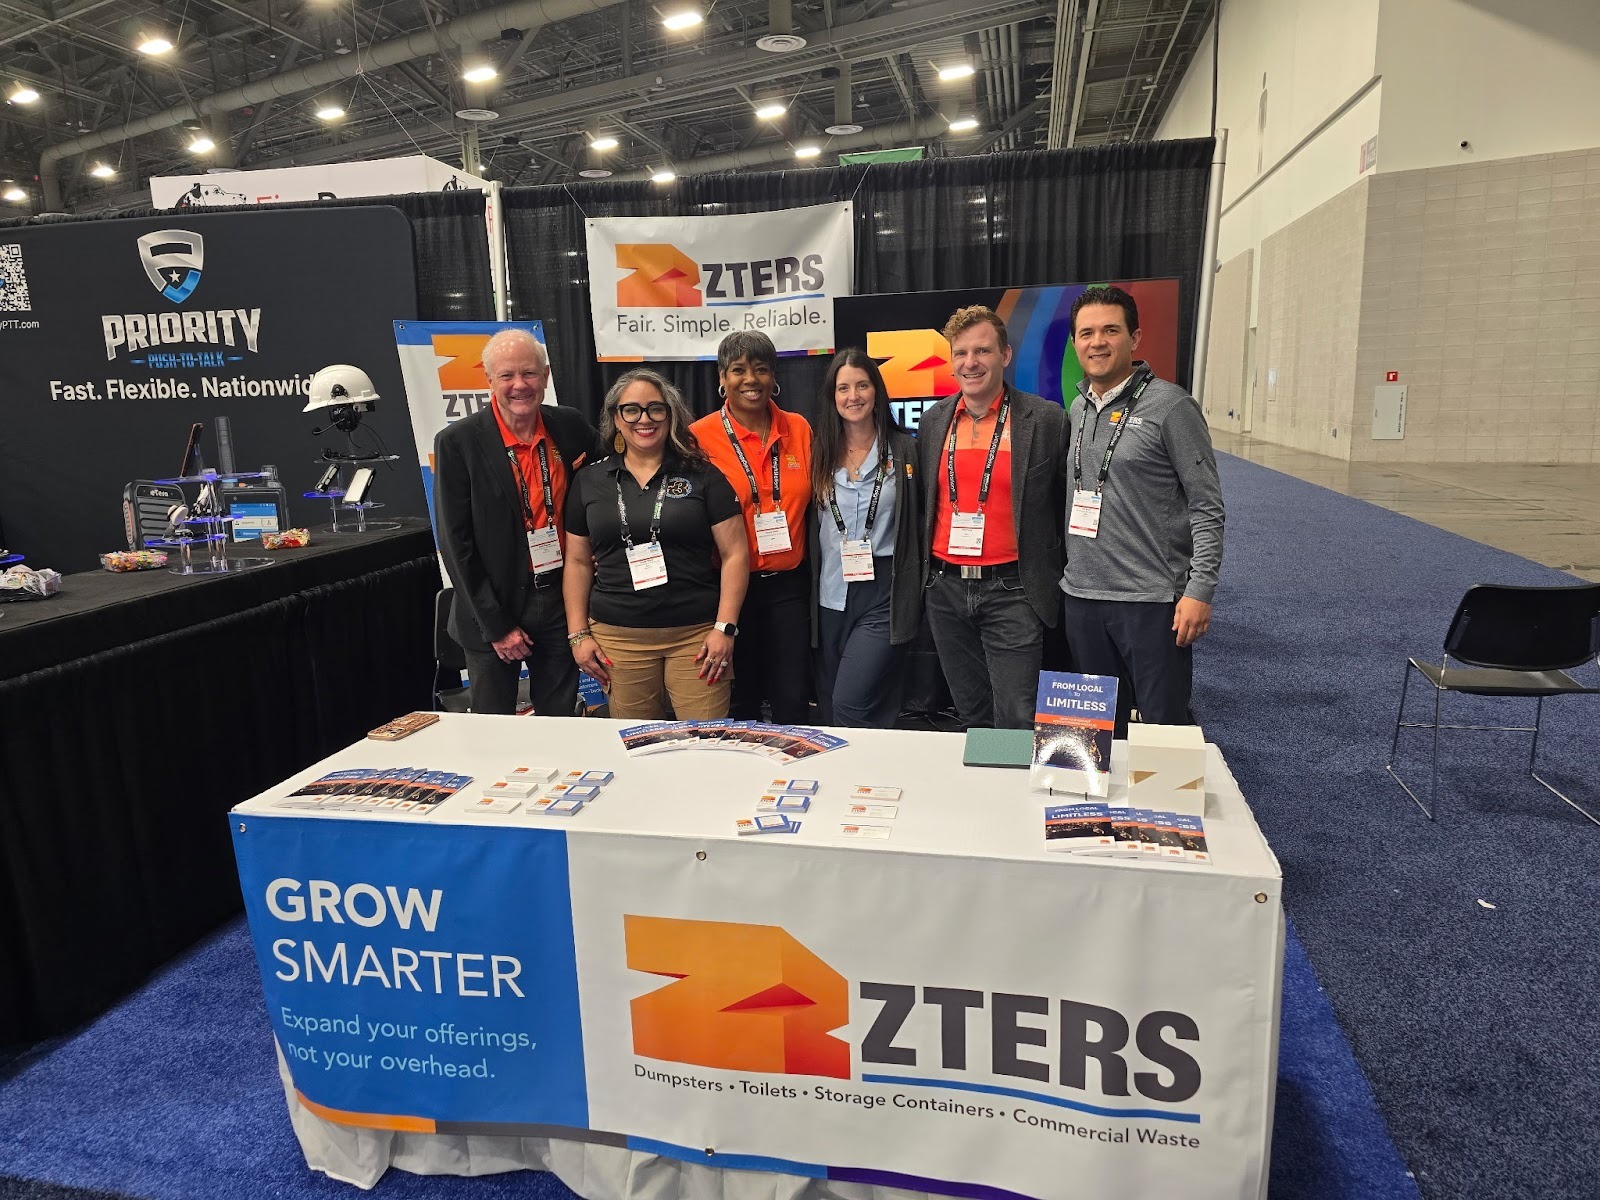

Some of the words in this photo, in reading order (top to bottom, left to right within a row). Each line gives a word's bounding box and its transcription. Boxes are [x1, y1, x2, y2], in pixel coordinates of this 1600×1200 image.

[702, 254, 825, 298] ZTERS
[101, 308, 260, 361] PRIORITY
[617, 314, 656, 332] Fair.
[663, 313, 736, 337] Simple.
[744, 305, 827, 330] Reliable.
[147, 351, 225, 368] PUSH-TO-TALK
[50, 380, 102, 401] Fast.
[106, 377, 197, 400] Flexible.
[201, 373, 315, 398] Nationwid
[442, 393, 489, 417] ZTE
[1046, 696, 1107, 712] LIMITLESS
[1052, 681, 1076, 690] FROM
[1076, 684, 1104, 693] LOCAL
[1051, 811, 1104, 819] LIMITLESS
[265, 877, 443, 932] GROW
[272, 938, 526, 998] SMARTER
[281, 1006, 360, 1036] Expand
[367, 1021, 418, 1043] your
[425, 1022, 537, 1052] offerings,
[859, 981, 1201, 1103] ZTERS
[287, 1041, 318, 1064] not
[324, 1050, 373, 1071] your
[380, 1054, 496, 1079] overhead.
[634, 1064, 723, 1092] Dumpsters
[738, 1080, 797, 1099] Toilets
[815, 1086, 886, 1109] Storage
[892, 1094, 994, 1118] Containers
[1013, 1108, 1130, 1143] Commercial
[1137, 1128, 1200, 1149] Waste
